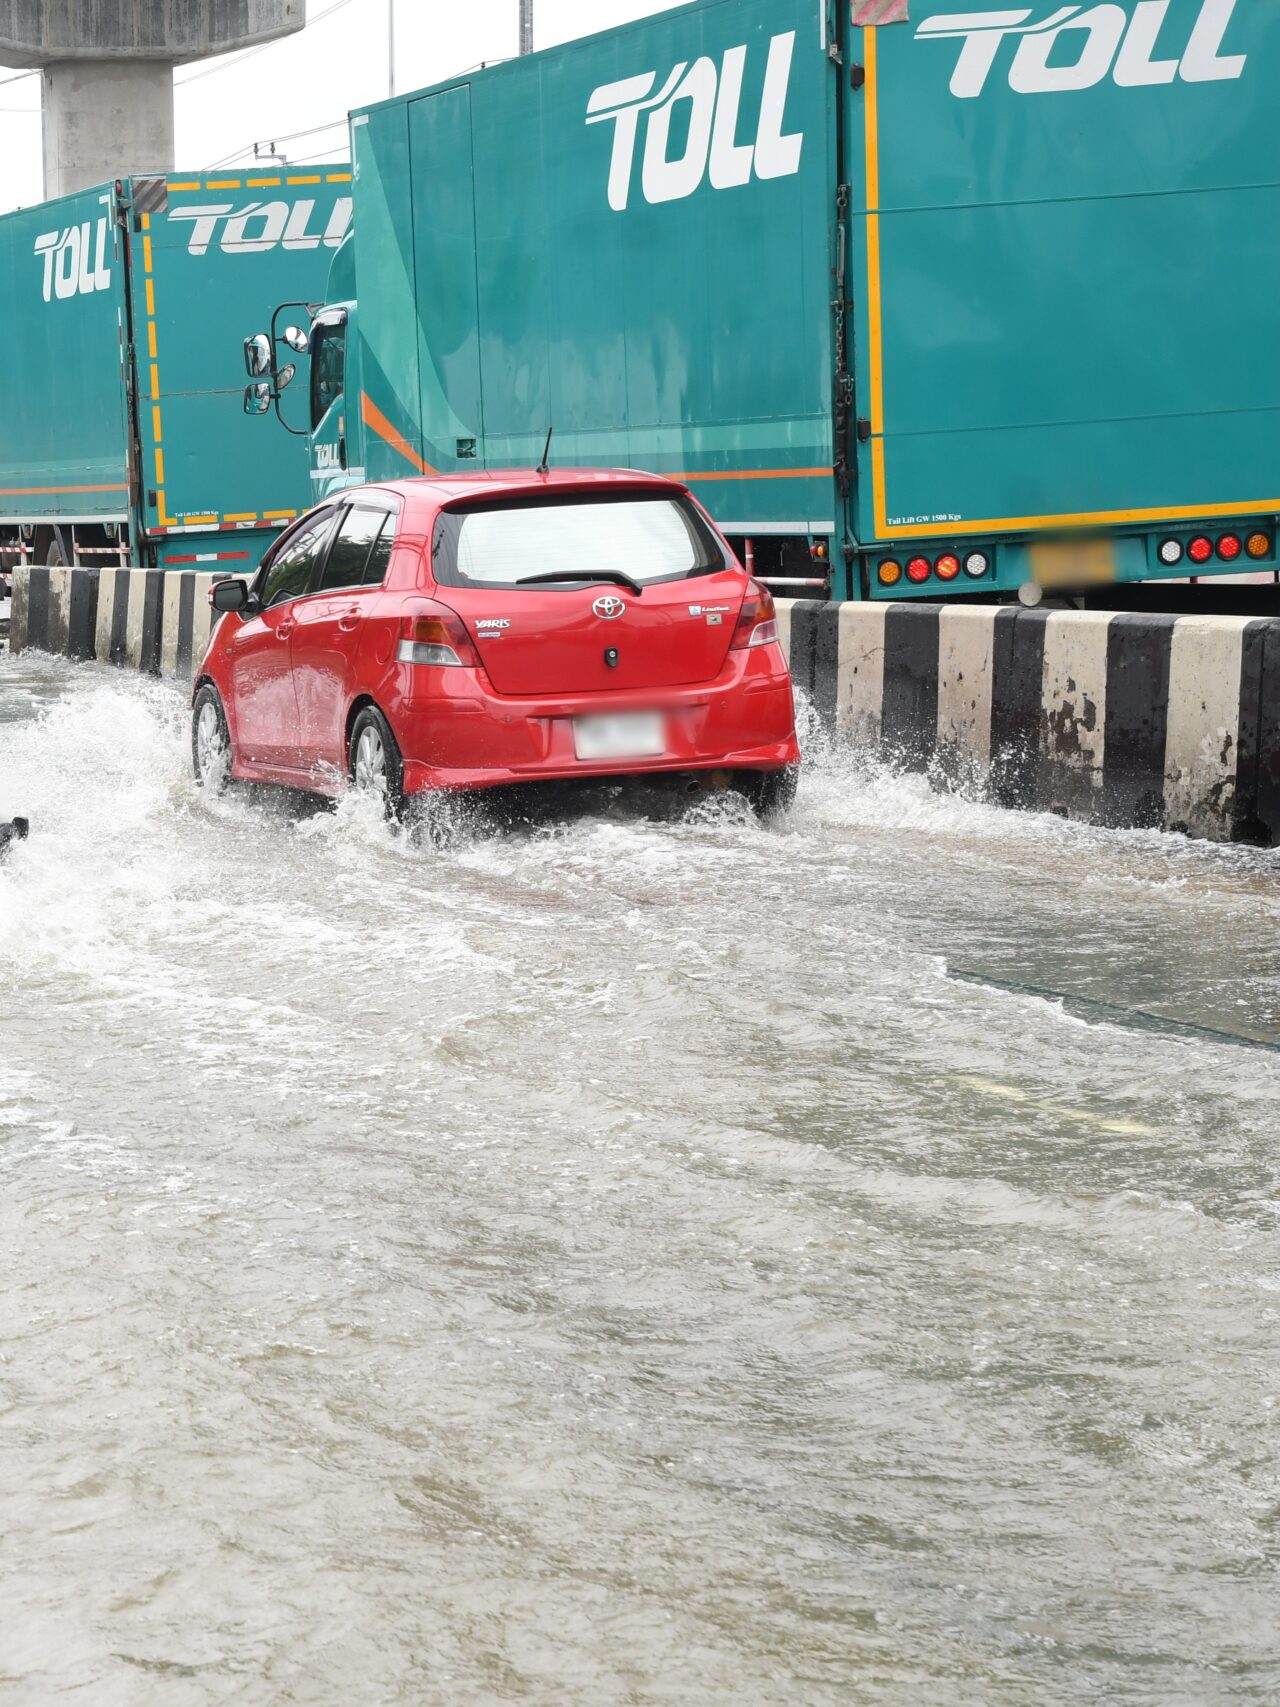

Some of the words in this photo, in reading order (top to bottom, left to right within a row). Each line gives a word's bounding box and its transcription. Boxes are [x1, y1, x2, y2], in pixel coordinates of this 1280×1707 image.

[913, 0, 1248, 98] TOLL
[585, 30, 803, 212] TOLL
[34, 217, 111, 302] TOLL
[314, 443, 340, 469] TOLL
[887, 517, 901, 525] Tail
[902, 516, 915, 524] Lift
[916, 515, 929, 523] GW
[948, 513, 962, 522] Kgs
